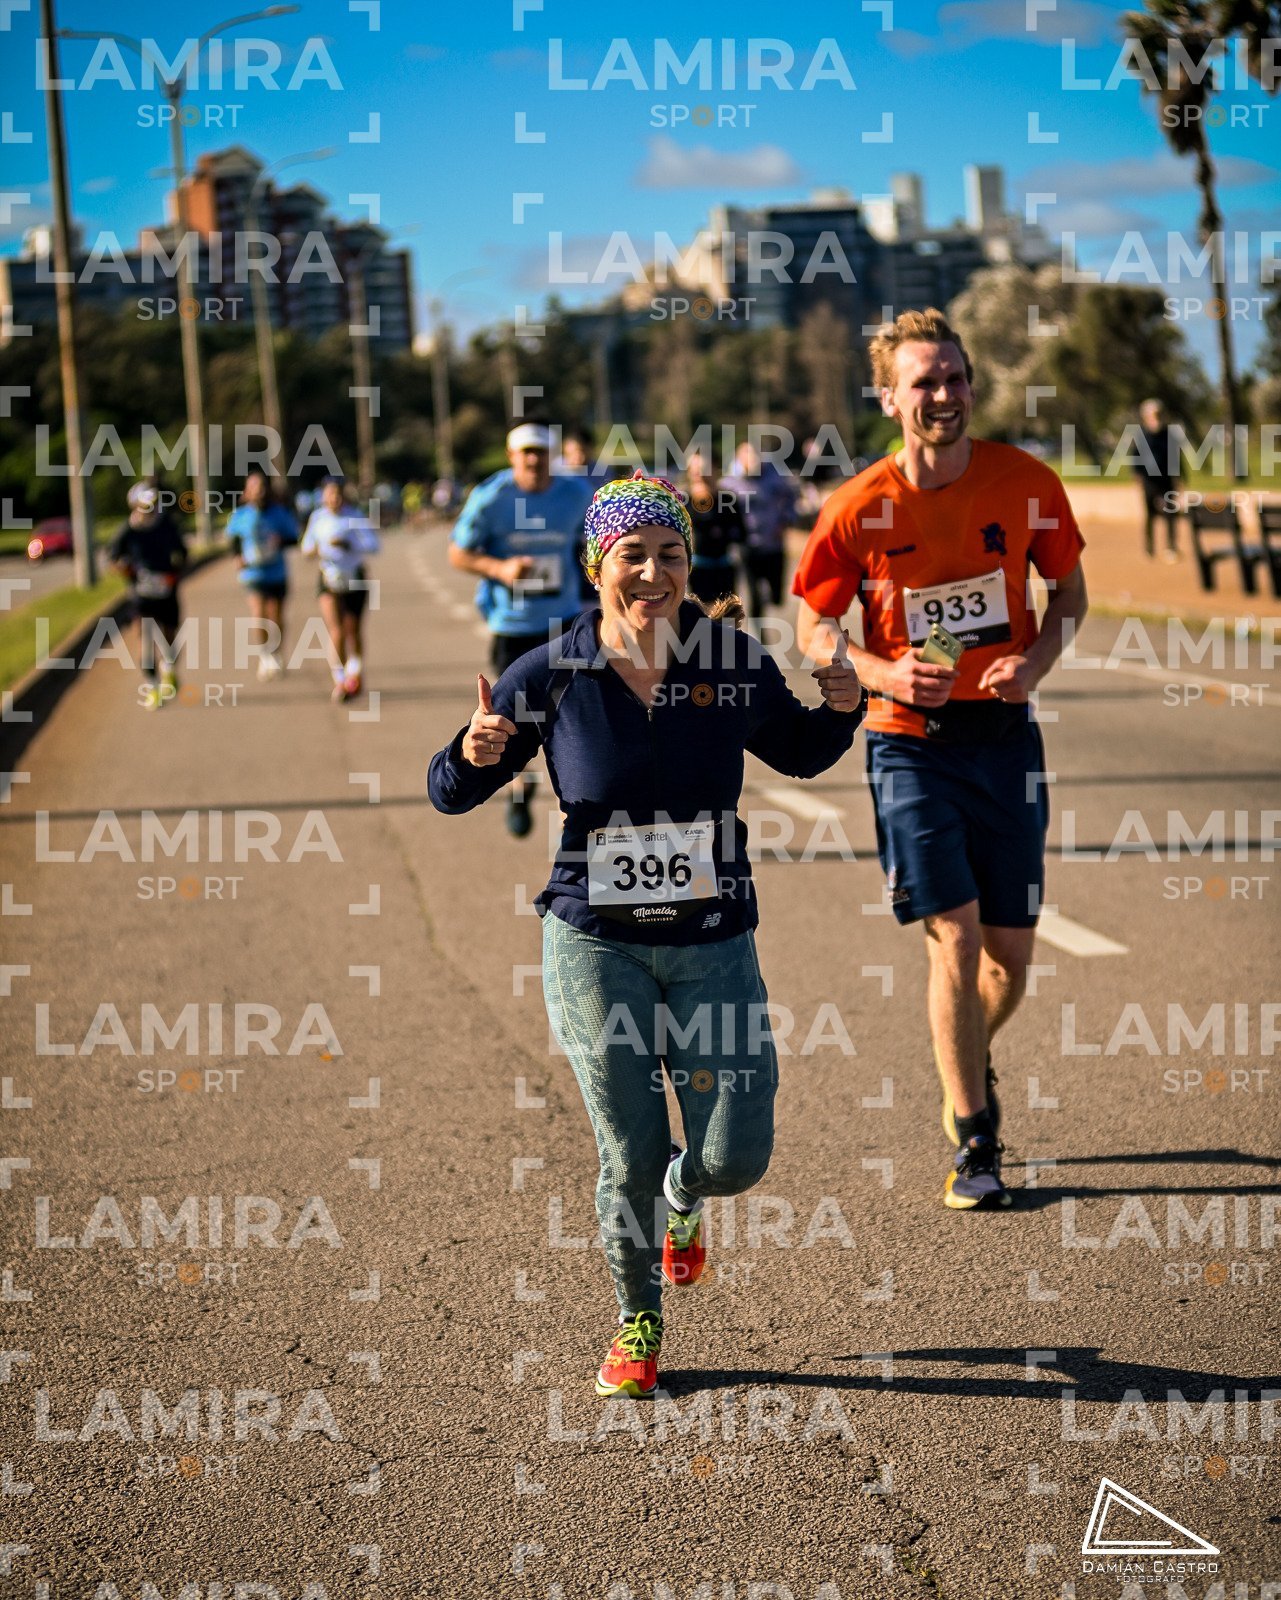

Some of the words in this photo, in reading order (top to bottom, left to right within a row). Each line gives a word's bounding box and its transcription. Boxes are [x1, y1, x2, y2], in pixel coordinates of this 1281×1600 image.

[924, 591, 988, 626] 933
[645, 832, 668, 842] antel
[613, 852, 692, 891] 396
[633, 906, 678, 918] Maratón
